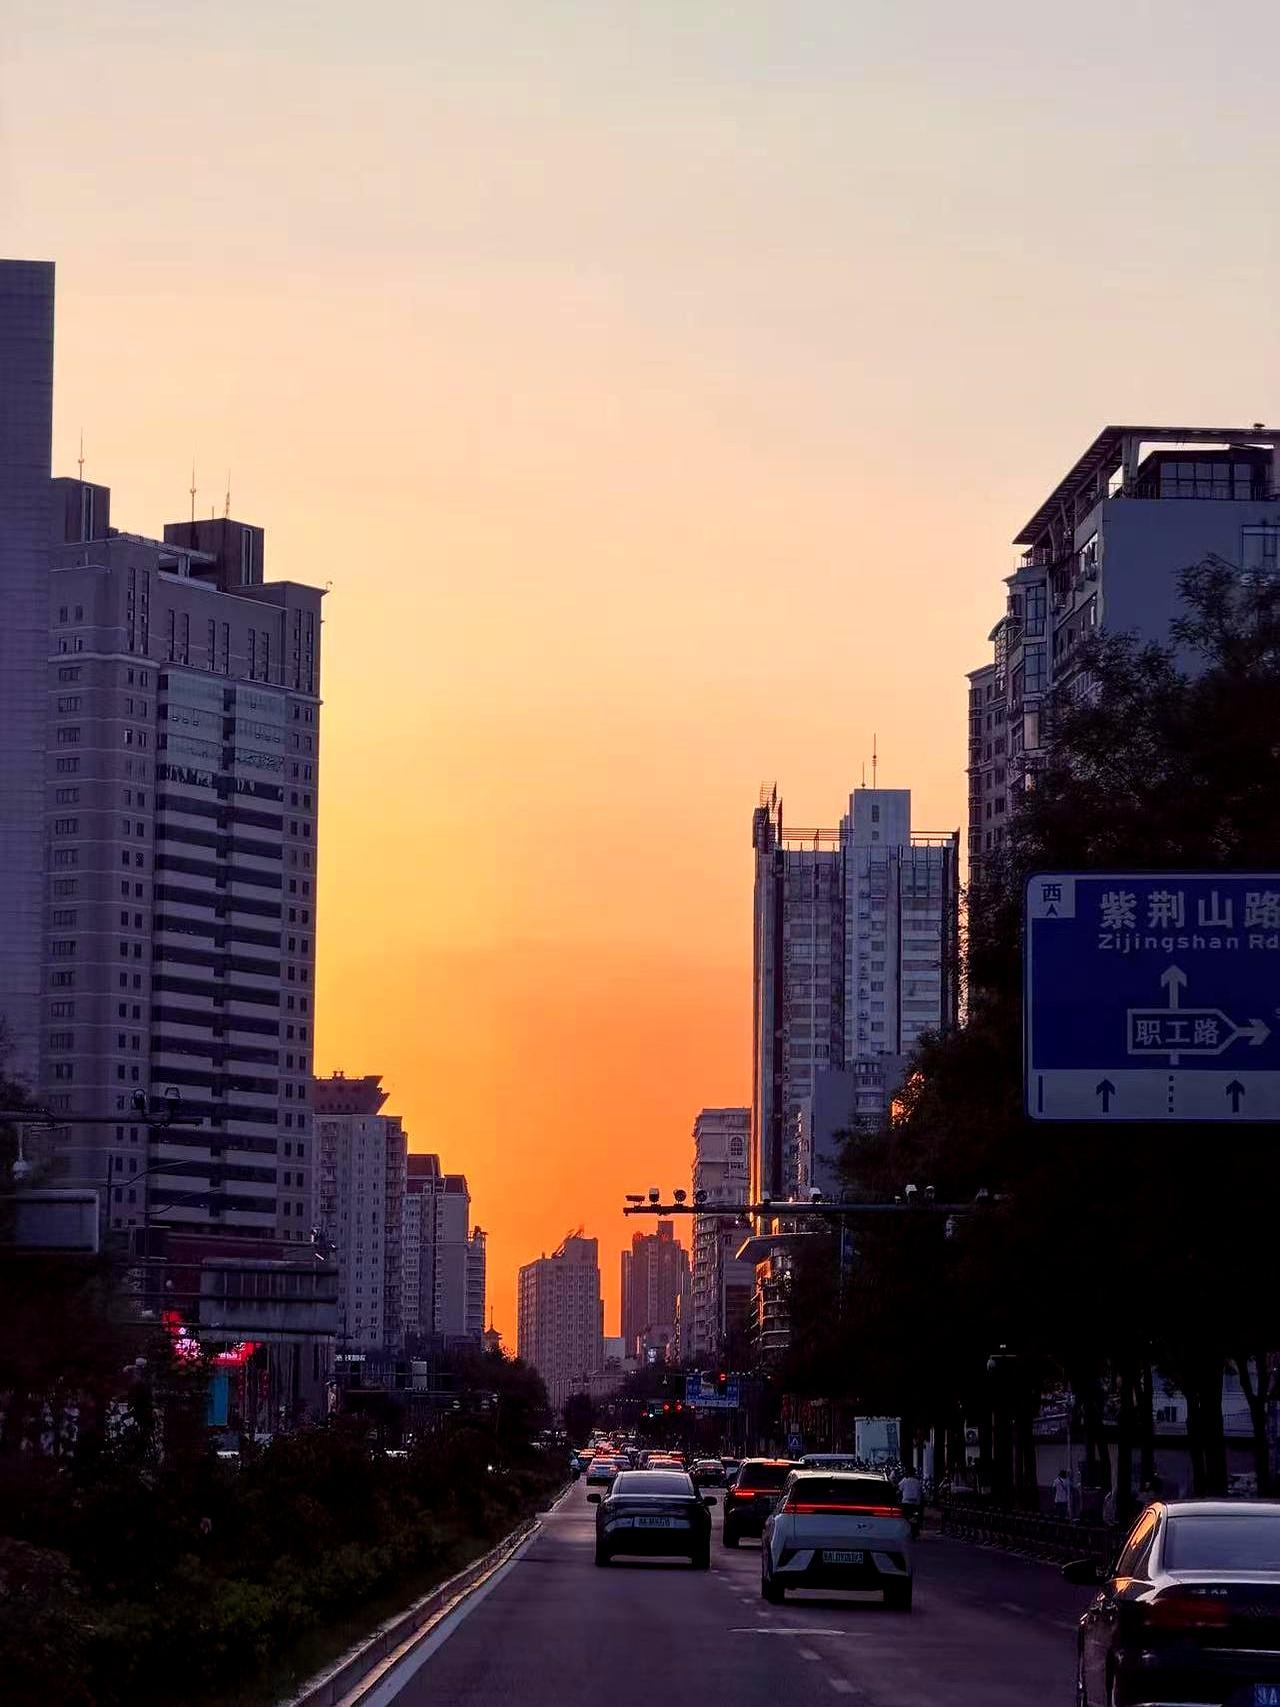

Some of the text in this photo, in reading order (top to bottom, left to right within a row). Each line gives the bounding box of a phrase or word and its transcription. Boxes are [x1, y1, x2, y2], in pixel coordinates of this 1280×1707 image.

[1041, 884, 1062, 902] 西
[1099, 891, 1280, 929] 紫荆山路
[1098, 933, 1280, 954] Zijingshan Rd
[1135, 1019, 1220, 1046] 职工路
